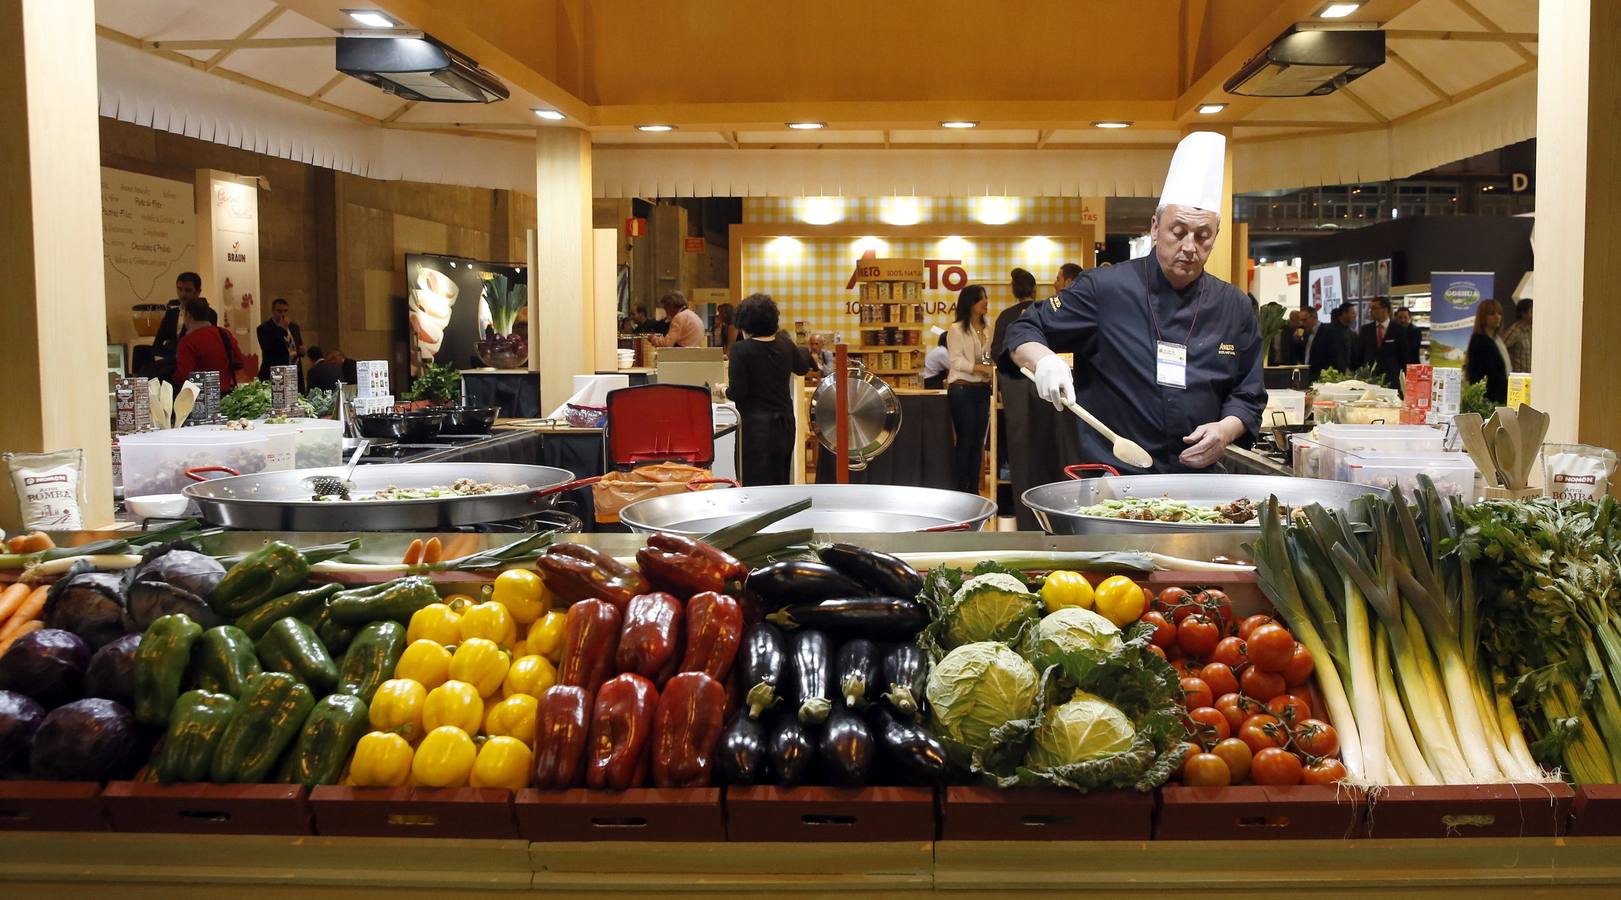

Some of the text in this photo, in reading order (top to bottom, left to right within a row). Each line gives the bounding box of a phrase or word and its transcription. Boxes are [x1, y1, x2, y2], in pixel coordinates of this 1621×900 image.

[1512, 173, 1529, 192] D
[227, 253, 246, 263] BRAUN
[27, 490, 71, 502] BOMBA
